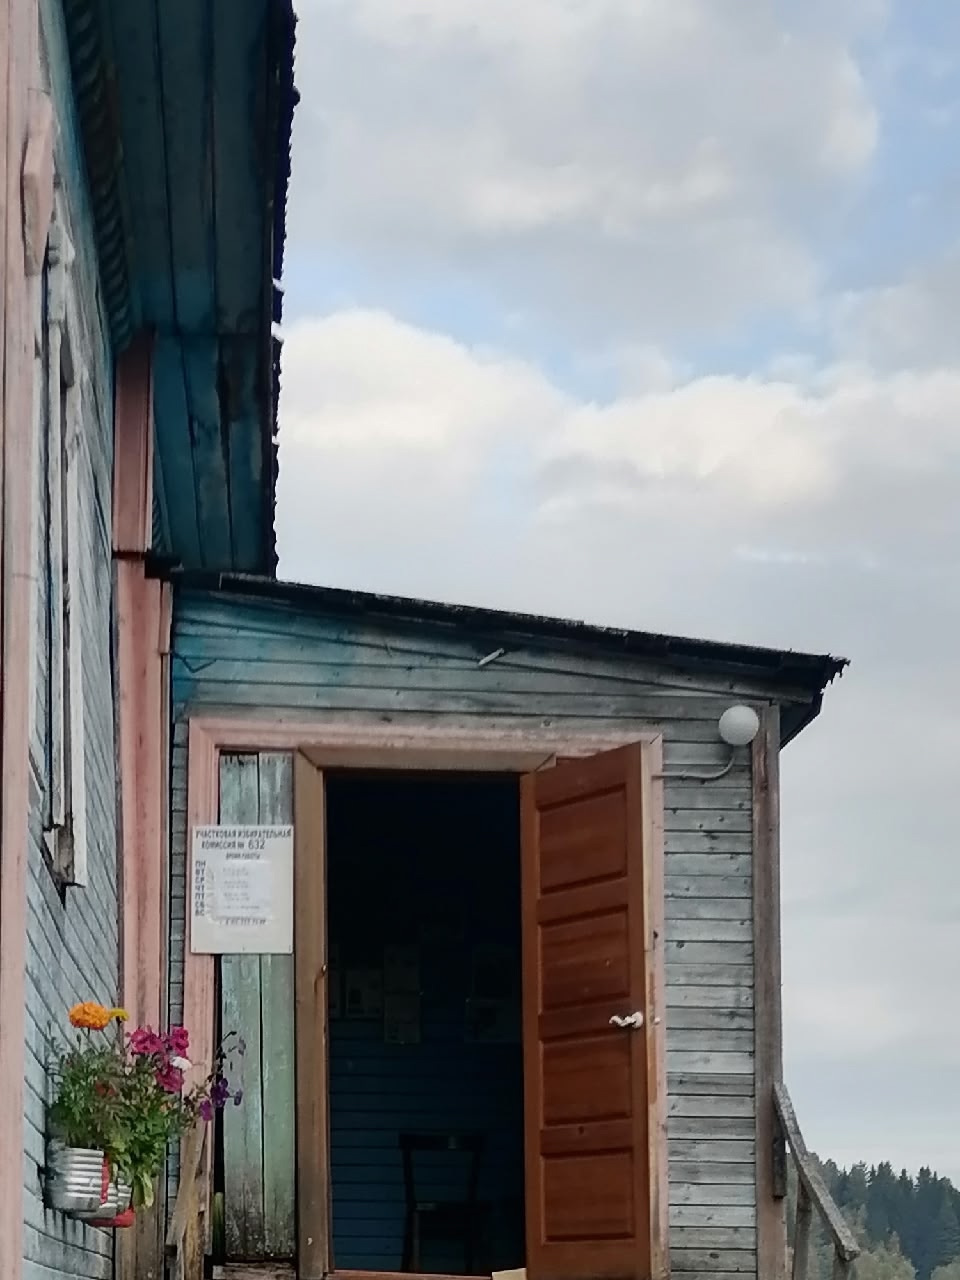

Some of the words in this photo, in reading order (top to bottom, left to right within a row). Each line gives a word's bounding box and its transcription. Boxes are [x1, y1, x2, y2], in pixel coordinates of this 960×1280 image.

[195, 829, 237, 839] УЧАСТКОВАЯ
[238, 828, 292, 839] ИЗБИРАТЕЛЬНАЯ
[202, 840, 236, 849] КОМИССИЯ
[248, 839, 265, 849] 632
